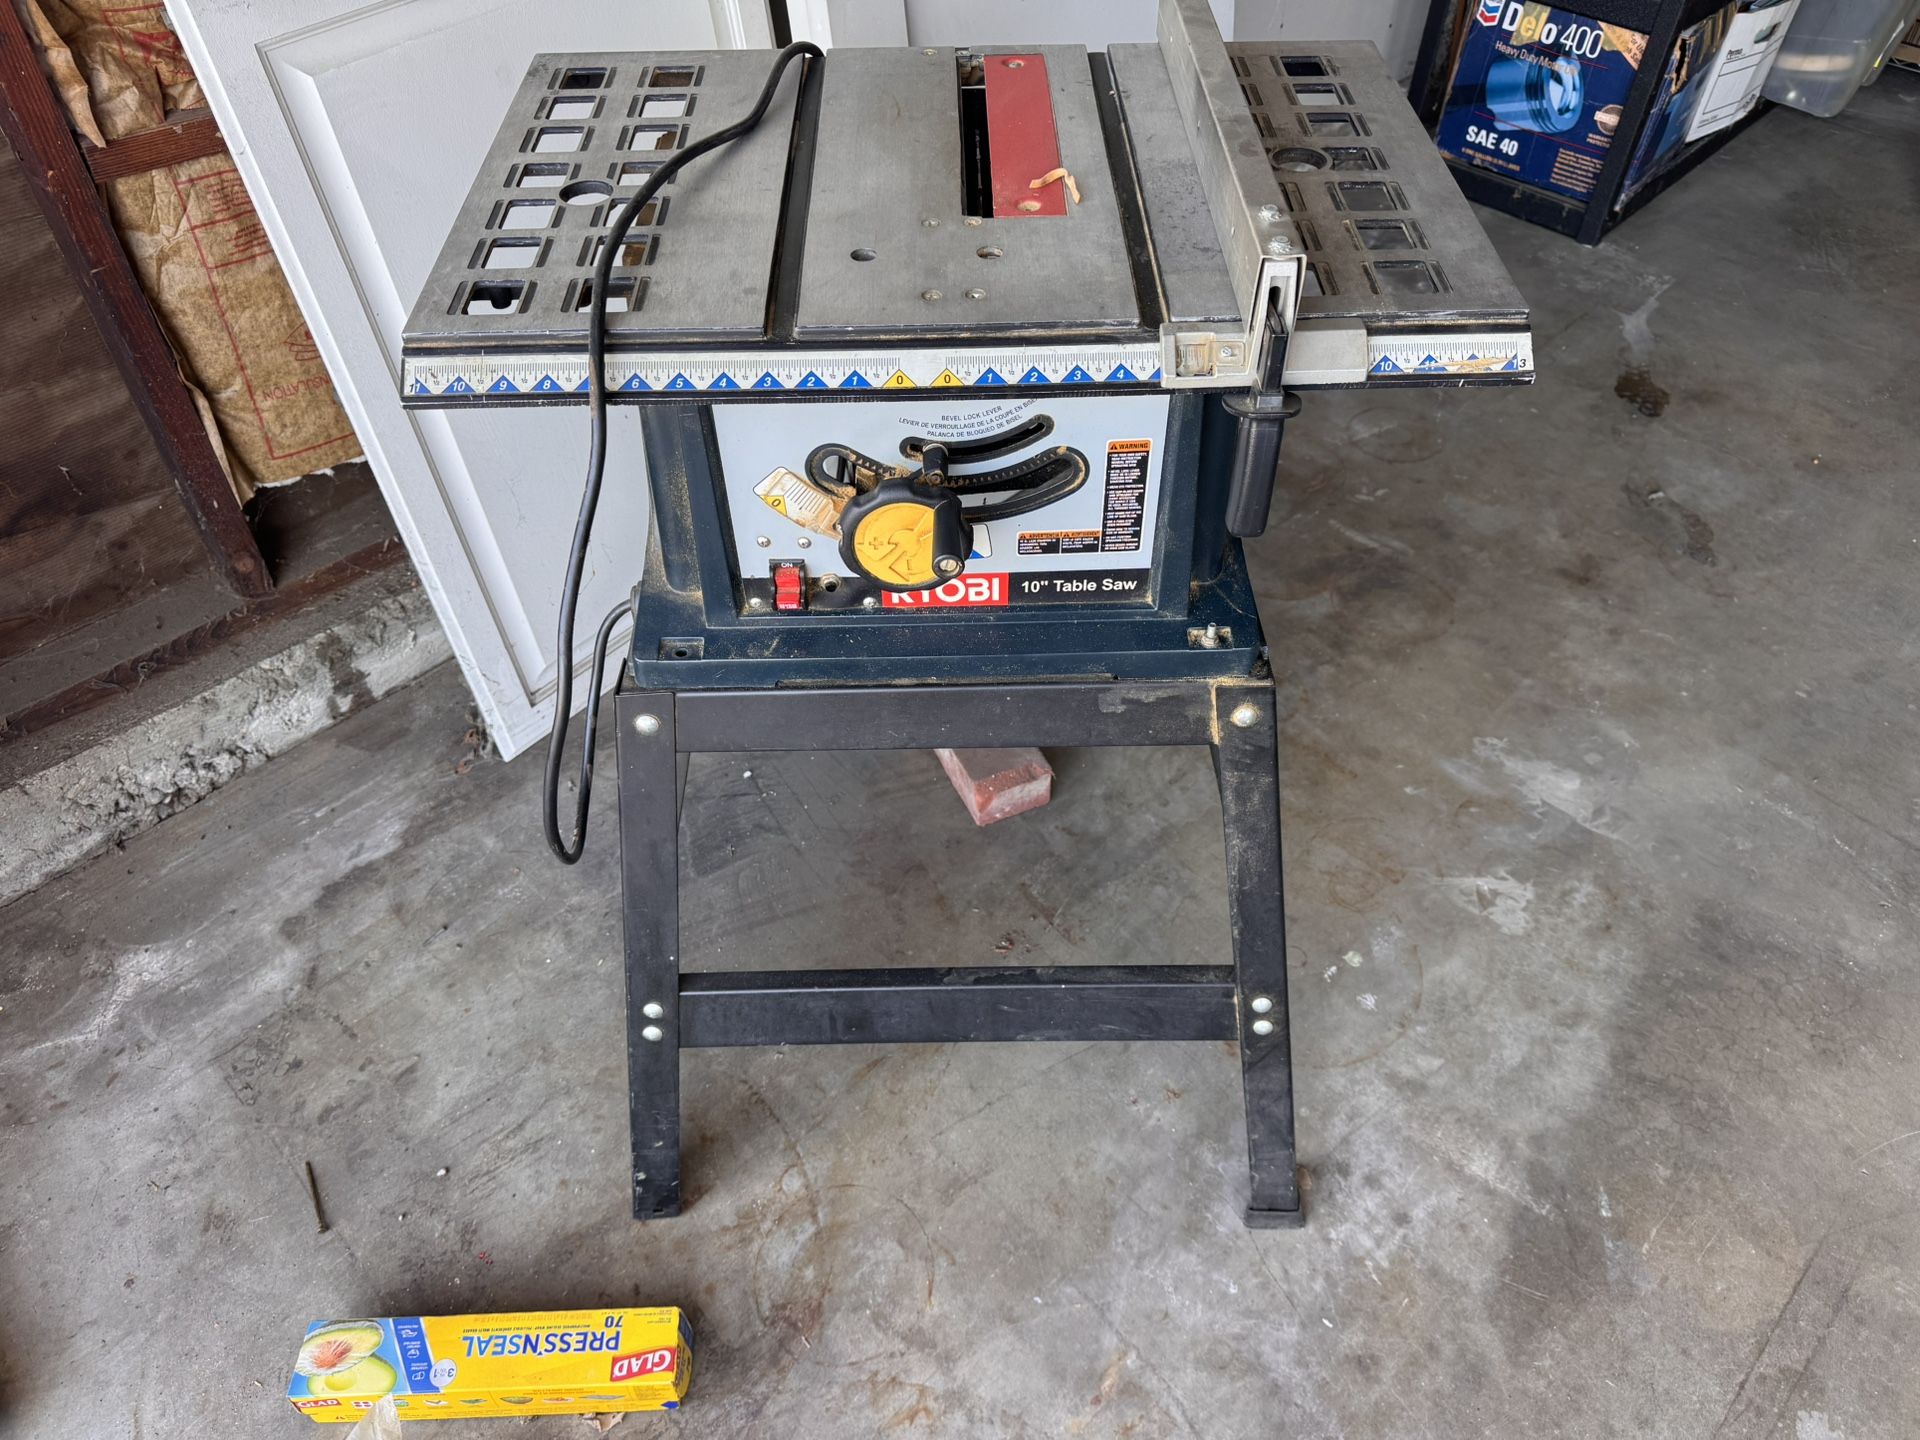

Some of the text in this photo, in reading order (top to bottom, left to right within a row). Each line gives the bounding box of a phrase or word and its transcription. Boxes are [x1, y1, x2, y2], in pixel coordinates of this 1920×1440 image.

[1501, 1, 1559, 45] Delo
[1560, 23, 1604, 58] 400
[1495, 40, 1520, 58] Heavy
[1519, 48, 1539, 65] Duty
[1465, 125, 1519, 156] SAE 40
[1379, 361, 1392, 371] 10
[262, 373, 331, 401] NSULATION
[452, 381, 465, 391] 10
[498, 380, 507, 390] 9
[542, 379, 551, 389] 8
[631, 379, 639, 389] 6
[675, 378, 684, 388] 5
[718, 377, 727, 387] 4
[763, 377, 772, 387] 3
[807, 376, 815, 386] 2
[852, 376, 858, 385] 1
[896, 375, 904, 385] 0
[944, 374, 951, 384] 0
[987, 373, 992, 383] 1
[1030, 371, 1038, 381] 2
[1073, 370, 1081, 380] 3
[1116, 370, 1124, 379] 4
[898, 417, 920, 427] LEVIER
[931, 422, 976, 430] VERROUILLAGE
[994, 410, 1014, 422] COUPE
[1014, 405, 1024, 413] EN
[1023, 398, 1039, 409] BISE
[982, 405, 1003, 417] LEVER
[926, 430, 955, 438] PALANCA
[996, 421, 1005, 430] DE
[1006, 414, 1023, 426] BISEL
[1118, 441, 1149, 450] WARNING
[771, 498, 782, 508] 0
[1021, 578, 1138, 593] 10" Table Saw
[604, 1315, 623, 1328] 70
[447, 1367, 455, 1378] 3
[612, 1349, 672, 1378] GLAD
[299, 1399, 339, 1409] GLAD
